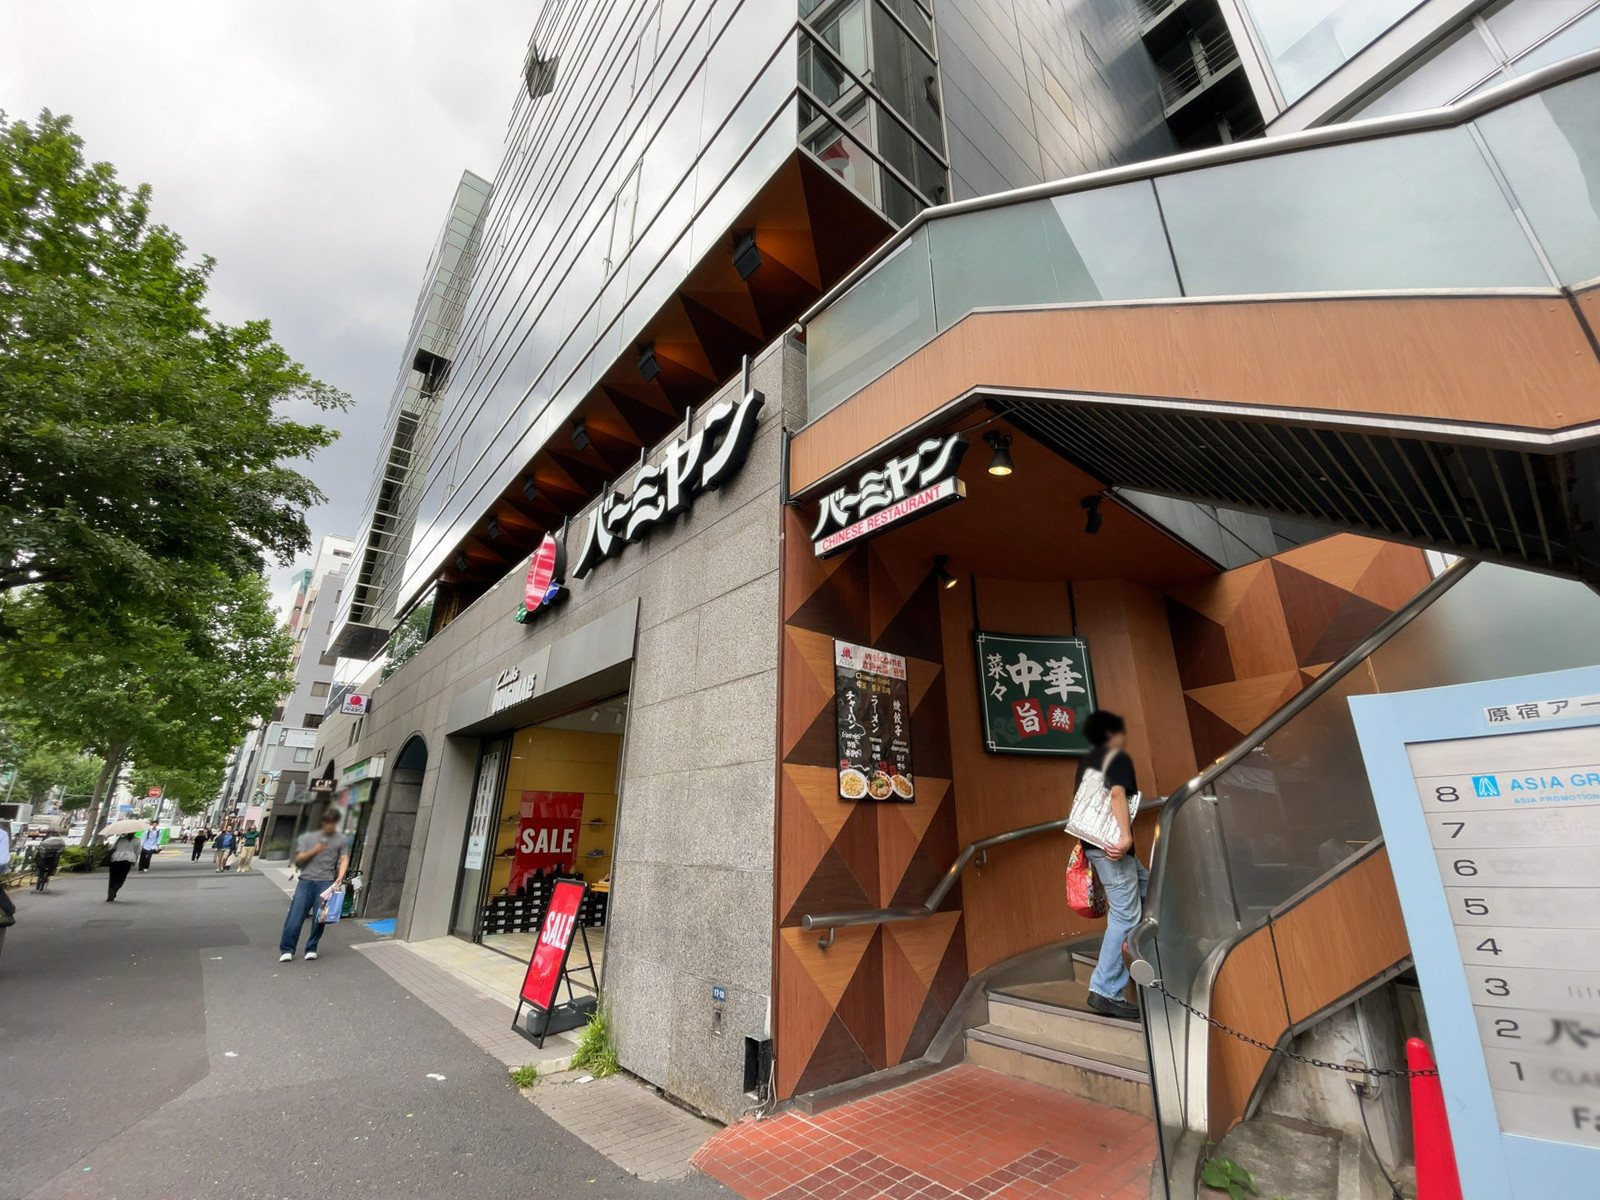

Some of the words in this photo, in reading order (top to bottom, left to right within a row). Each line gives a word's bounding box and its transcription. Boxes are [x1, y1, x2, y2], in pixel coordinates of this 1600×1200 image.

[572, 389, 763, 579] バーミヤン
[811, 433, 960, 541] バーミヤン
[822, 523, 865, 551] CHINESE
[866, 484, 942, 531] RESTAURANT
[865, 652, 902, 668] welcome
[986, 653, 1008, 702] 菜々
[1005, 652, 1086, 703] 中華
[845, 690, 857, 730] チャーハン
[871, 695, 880, 734] ラーメン
[1016, 702, 1040, 733] 旨
[1052, 707, 1070, 730] 熱
[1511, 775, 1565, 791] ASIA
[1570, 773, 1600, 788] GR
[1435, 786, 1460, 802] 8
[1514, 797, 1537, 805] ASIA
[1442, 822, 1465, 838] 7
[520, 828, 574, 854] SALE
[1453, 859, 1478, 876] 6
[1463, 898, 1489, 915] 5
[541, 910, 574, 950] SALE
[1476, 938, 1502, 955] 4
[1484, 977, 1510, 996] 3
[1494, 1019, 1521, 1039] 2
[1509, 1061, 1524, 1081] 1
